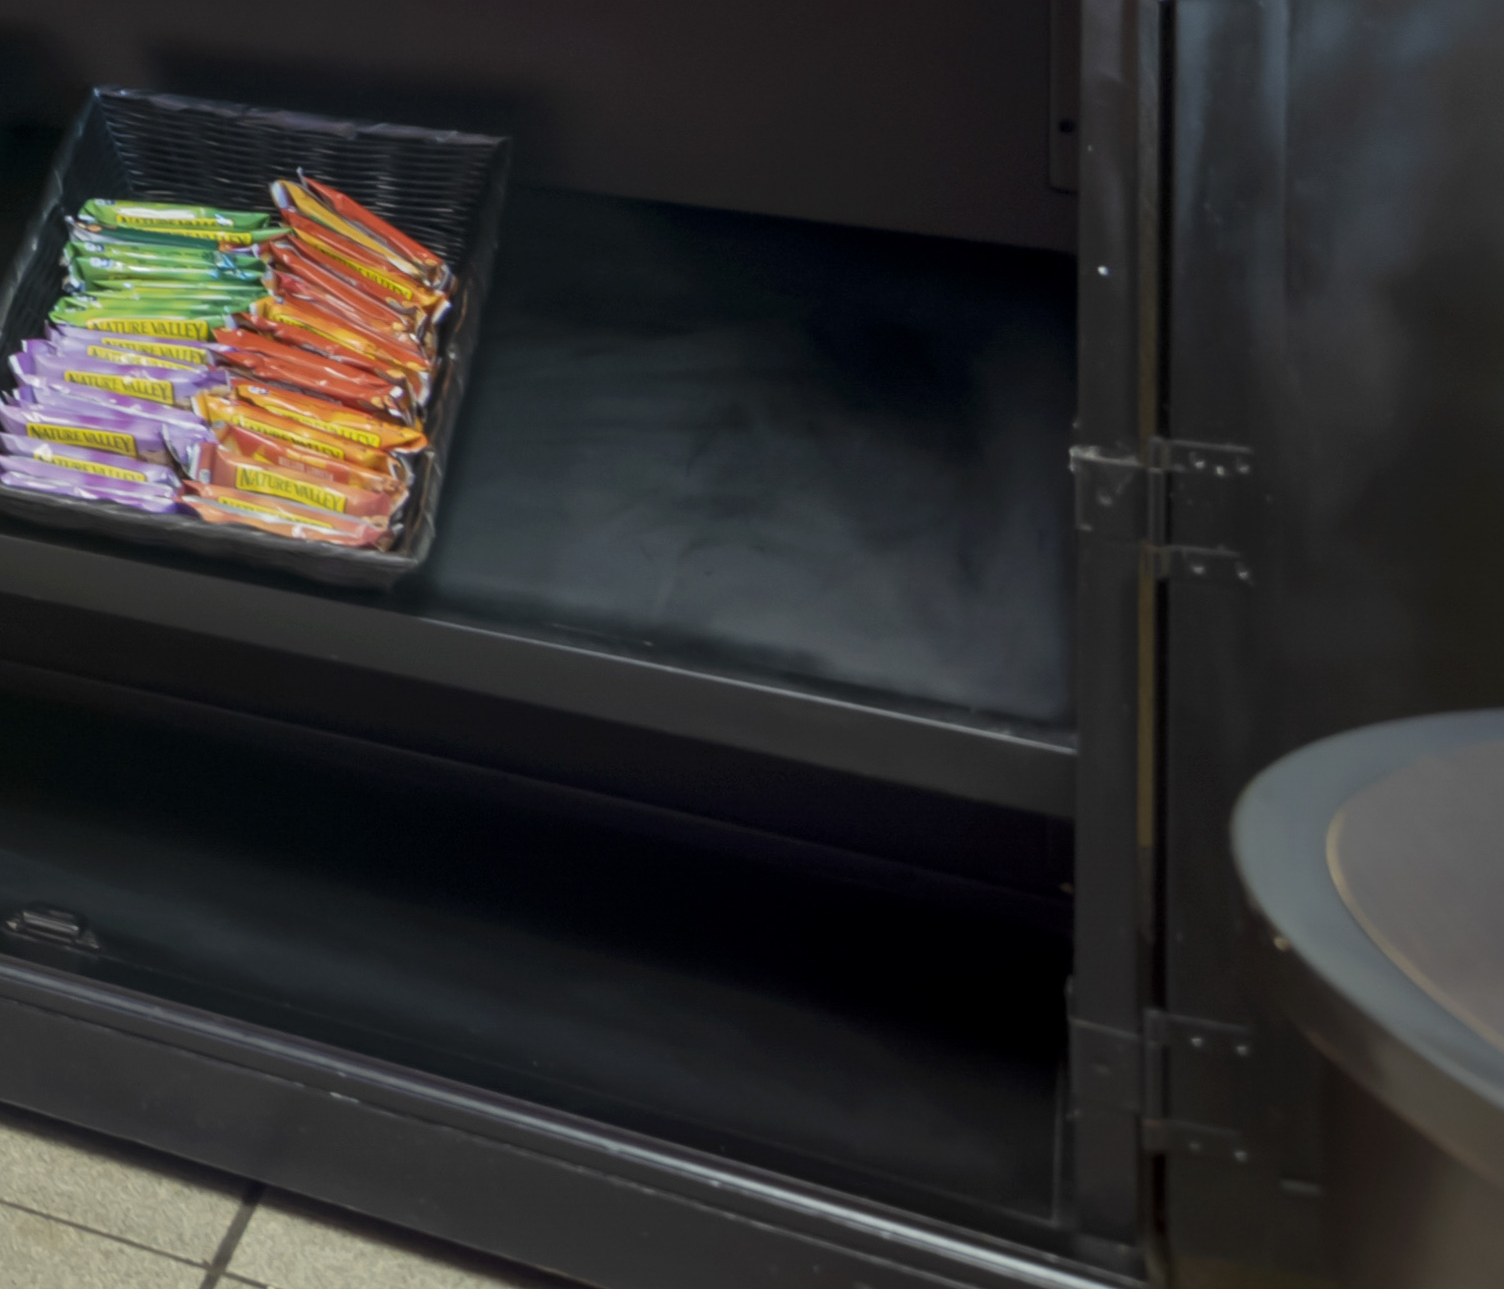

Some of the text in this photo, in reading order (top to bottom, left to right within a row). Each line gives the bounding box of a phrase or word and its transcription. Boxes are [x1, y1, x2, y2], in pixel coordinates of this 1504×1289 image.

[93, 321, 204, 341] NATURE VALLEY
[122, 381, 169, 401] VALLEY
[30, 425, 132, 455] NATURE VALLEY
[239, 468, 292, 492] NATURE
[294, 483, 345, 513] VALLEY
